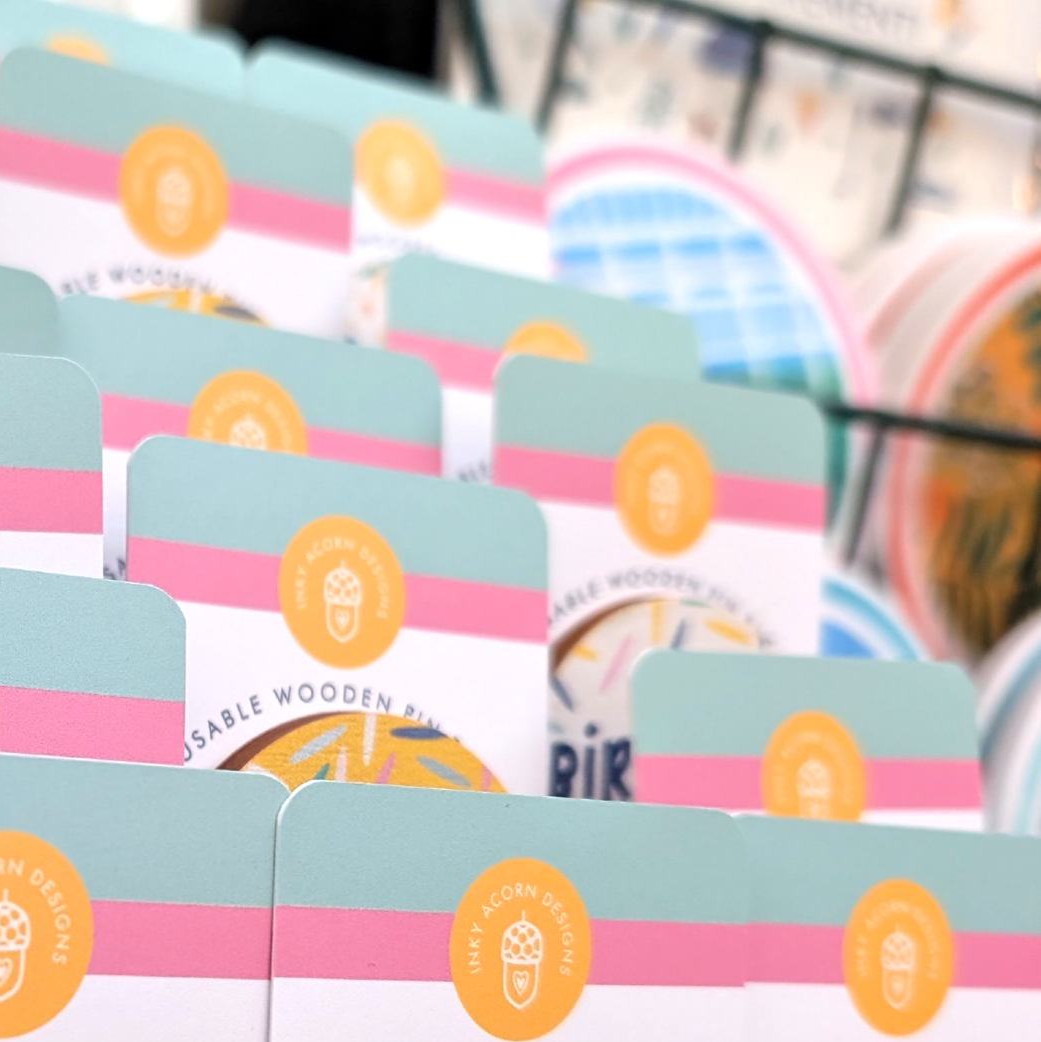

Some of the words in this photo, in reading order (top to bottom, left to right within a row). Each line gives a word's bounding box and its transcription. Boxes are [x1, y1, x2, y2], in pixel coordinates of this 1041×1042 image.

[306, 537, 355, 565] ACORN
[359, 546, 389, 620] DESIGNS
[273, 682, 391, 713] WOODEN
[29, 868, 71, 965] DESIGNS
[467, 922, 483, 974] INKY
[481, 882, 537, 919] ACORN
[542, 892, 574, 977] DESIGNS
